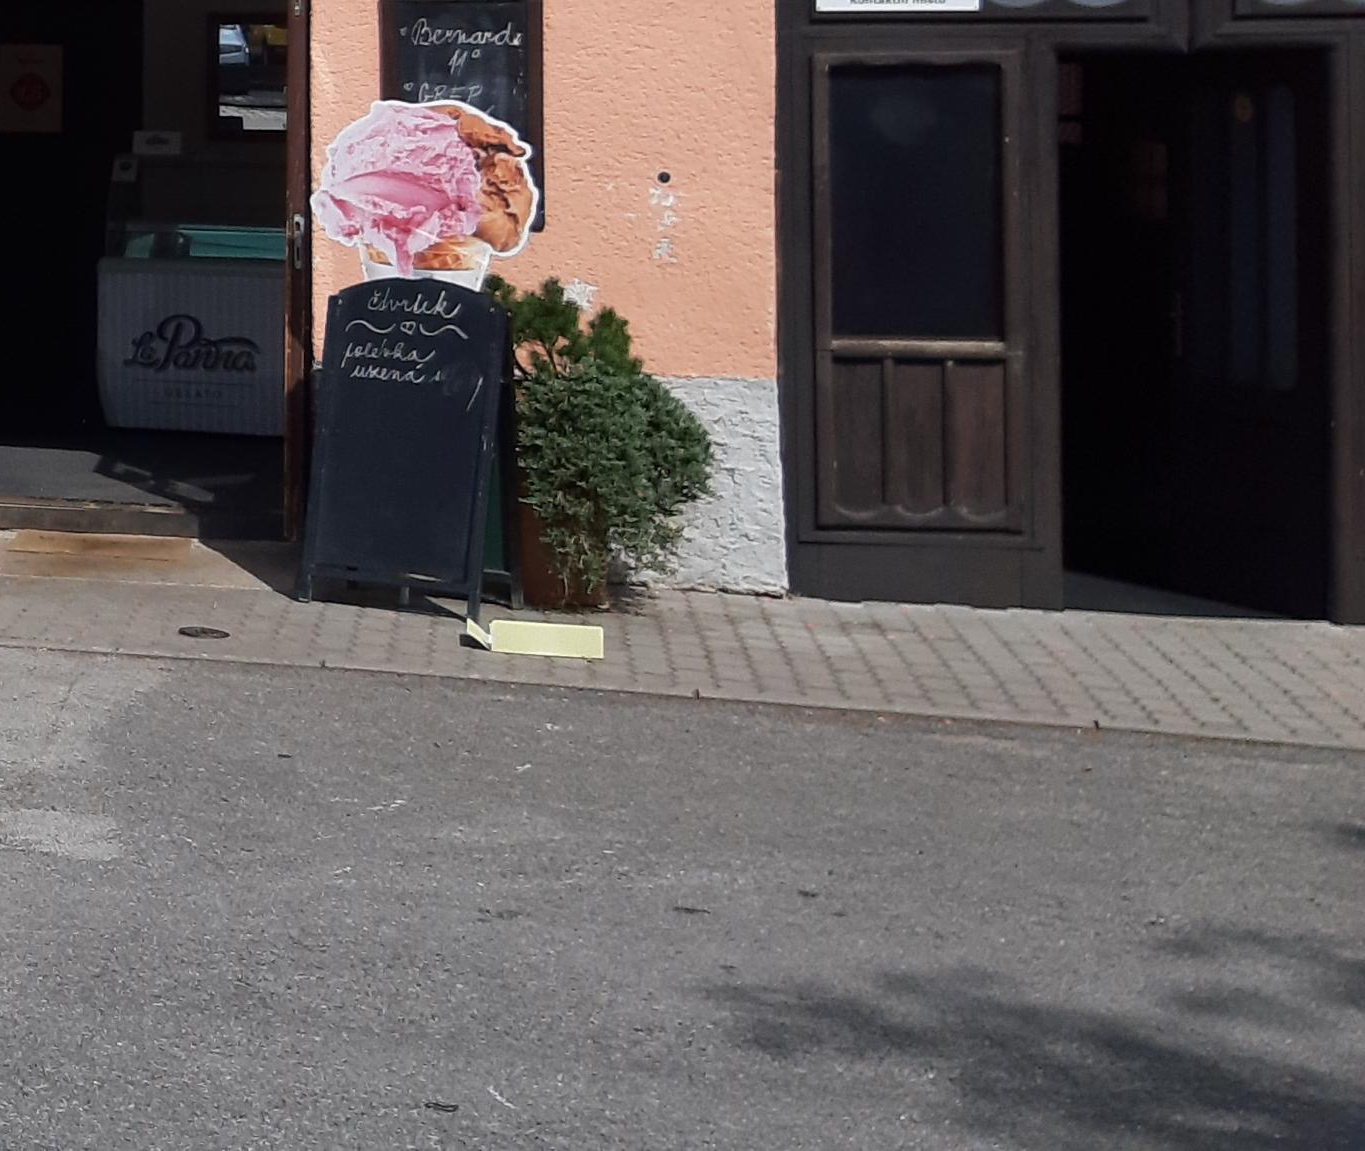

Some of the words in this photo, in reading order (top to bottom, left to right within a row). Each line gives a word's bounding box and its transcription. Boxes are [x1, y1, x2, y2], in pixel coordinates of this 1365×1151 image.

[367, 288, 462, 319] čtvrtek
[123, 331, 160, 369] La
[155, 314, 260, 372] Panna
